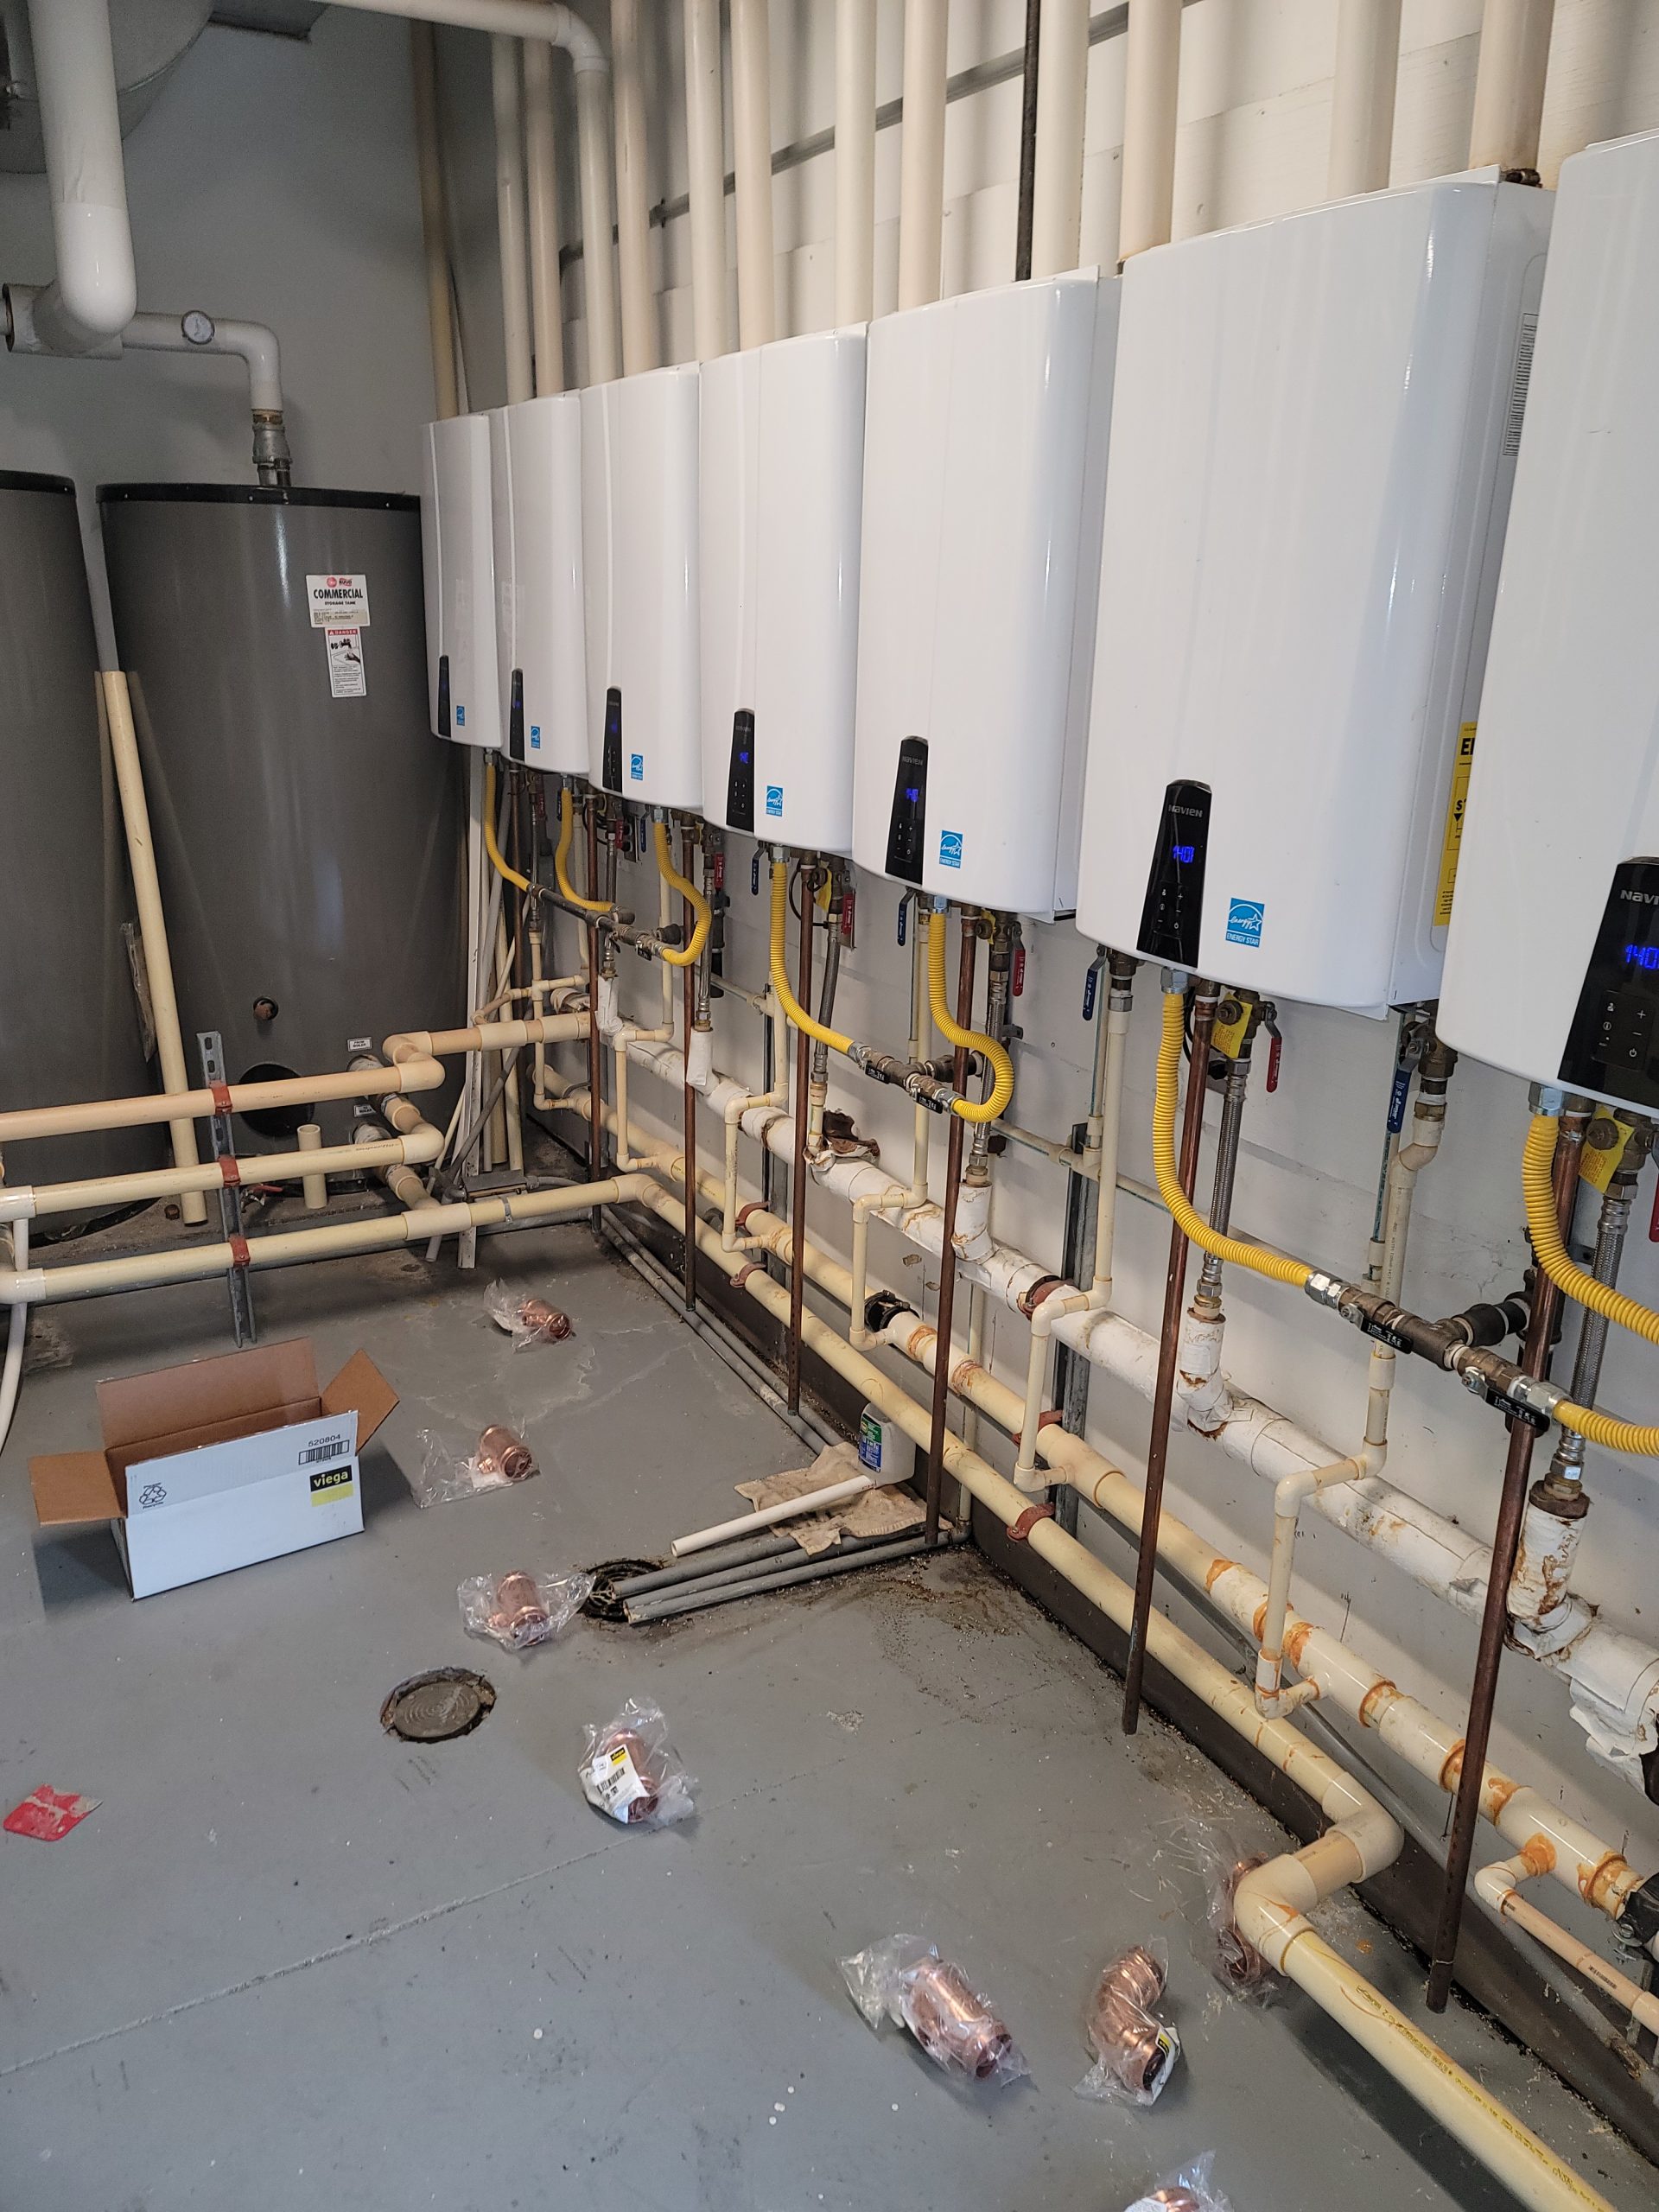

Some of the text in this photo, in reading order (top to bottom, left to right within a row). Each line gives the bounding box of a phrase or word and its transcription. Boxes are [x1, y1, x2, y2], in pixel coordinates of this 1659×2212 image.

[313, 588, 364, 599] COMMERCIAL
[1225, 932, 1260, 946] ENERGY STAR
[308, 1434, 341, 1447] 520804
[313, 1471, 348, 1488] viega
